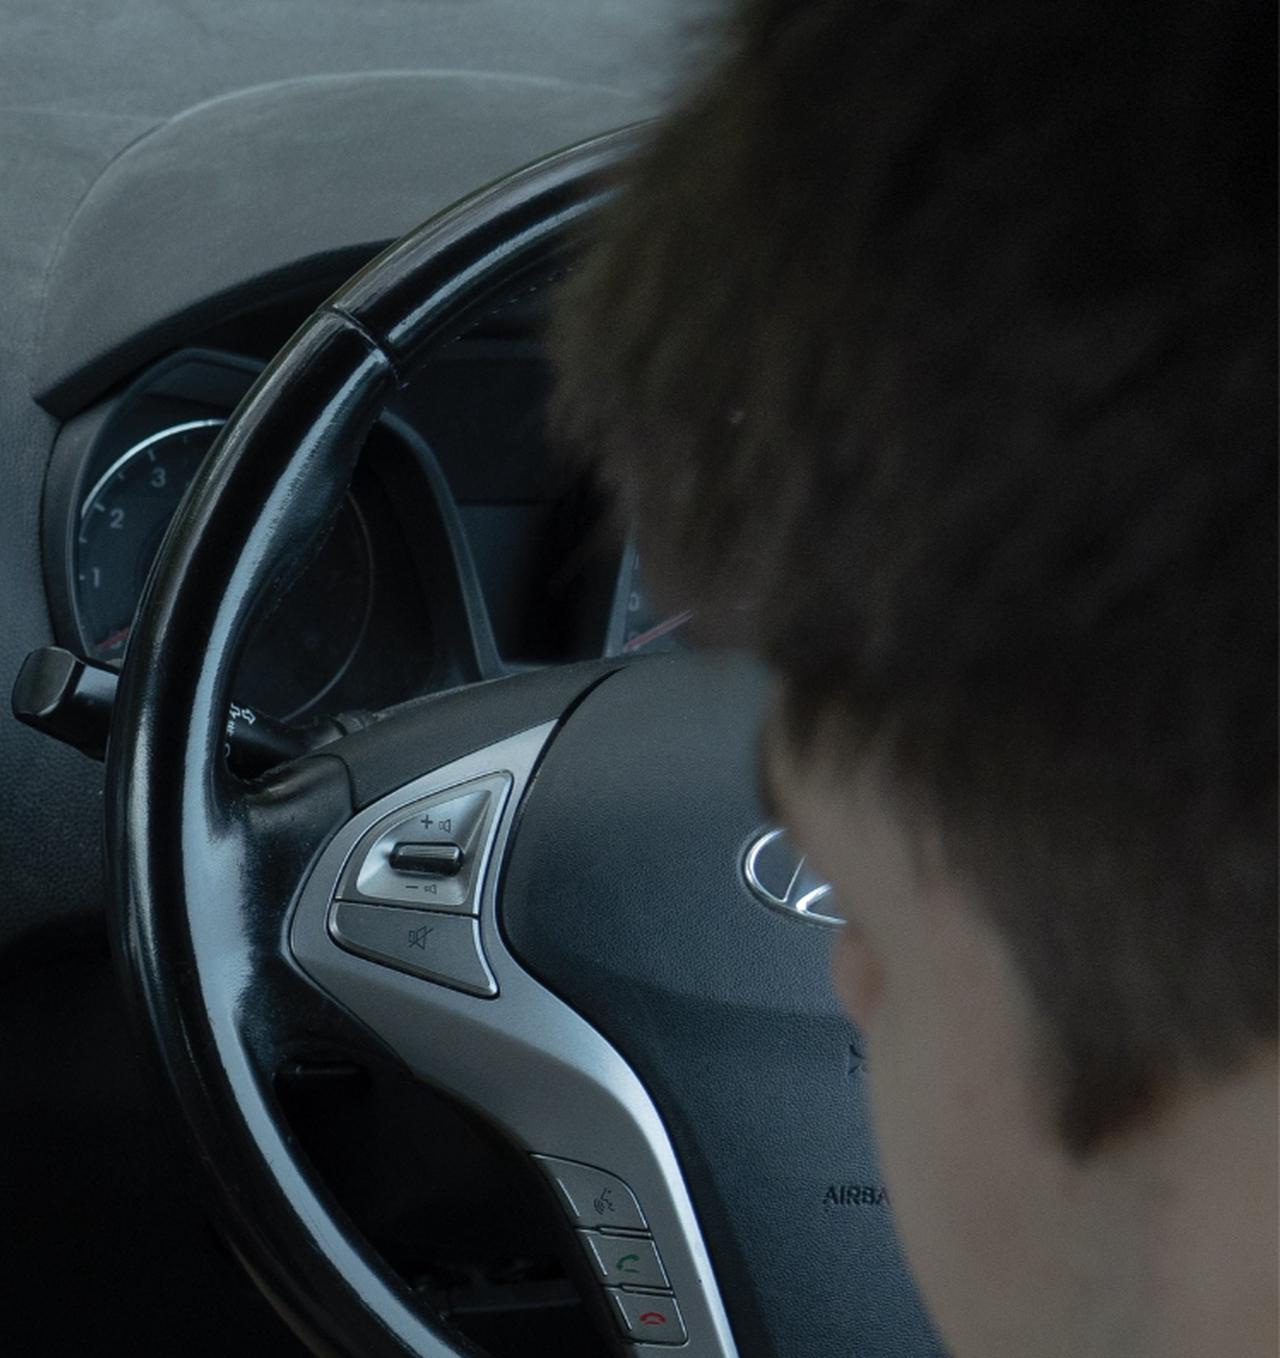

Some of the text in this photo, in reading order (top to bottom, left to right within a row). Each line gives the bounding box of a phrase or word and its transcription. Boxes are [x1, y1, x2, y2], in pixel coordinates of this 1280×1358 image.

[151, 467, 167, 488] 3
[109, 508, 125, 530] 2
[92, 567, 101, 587] 1
